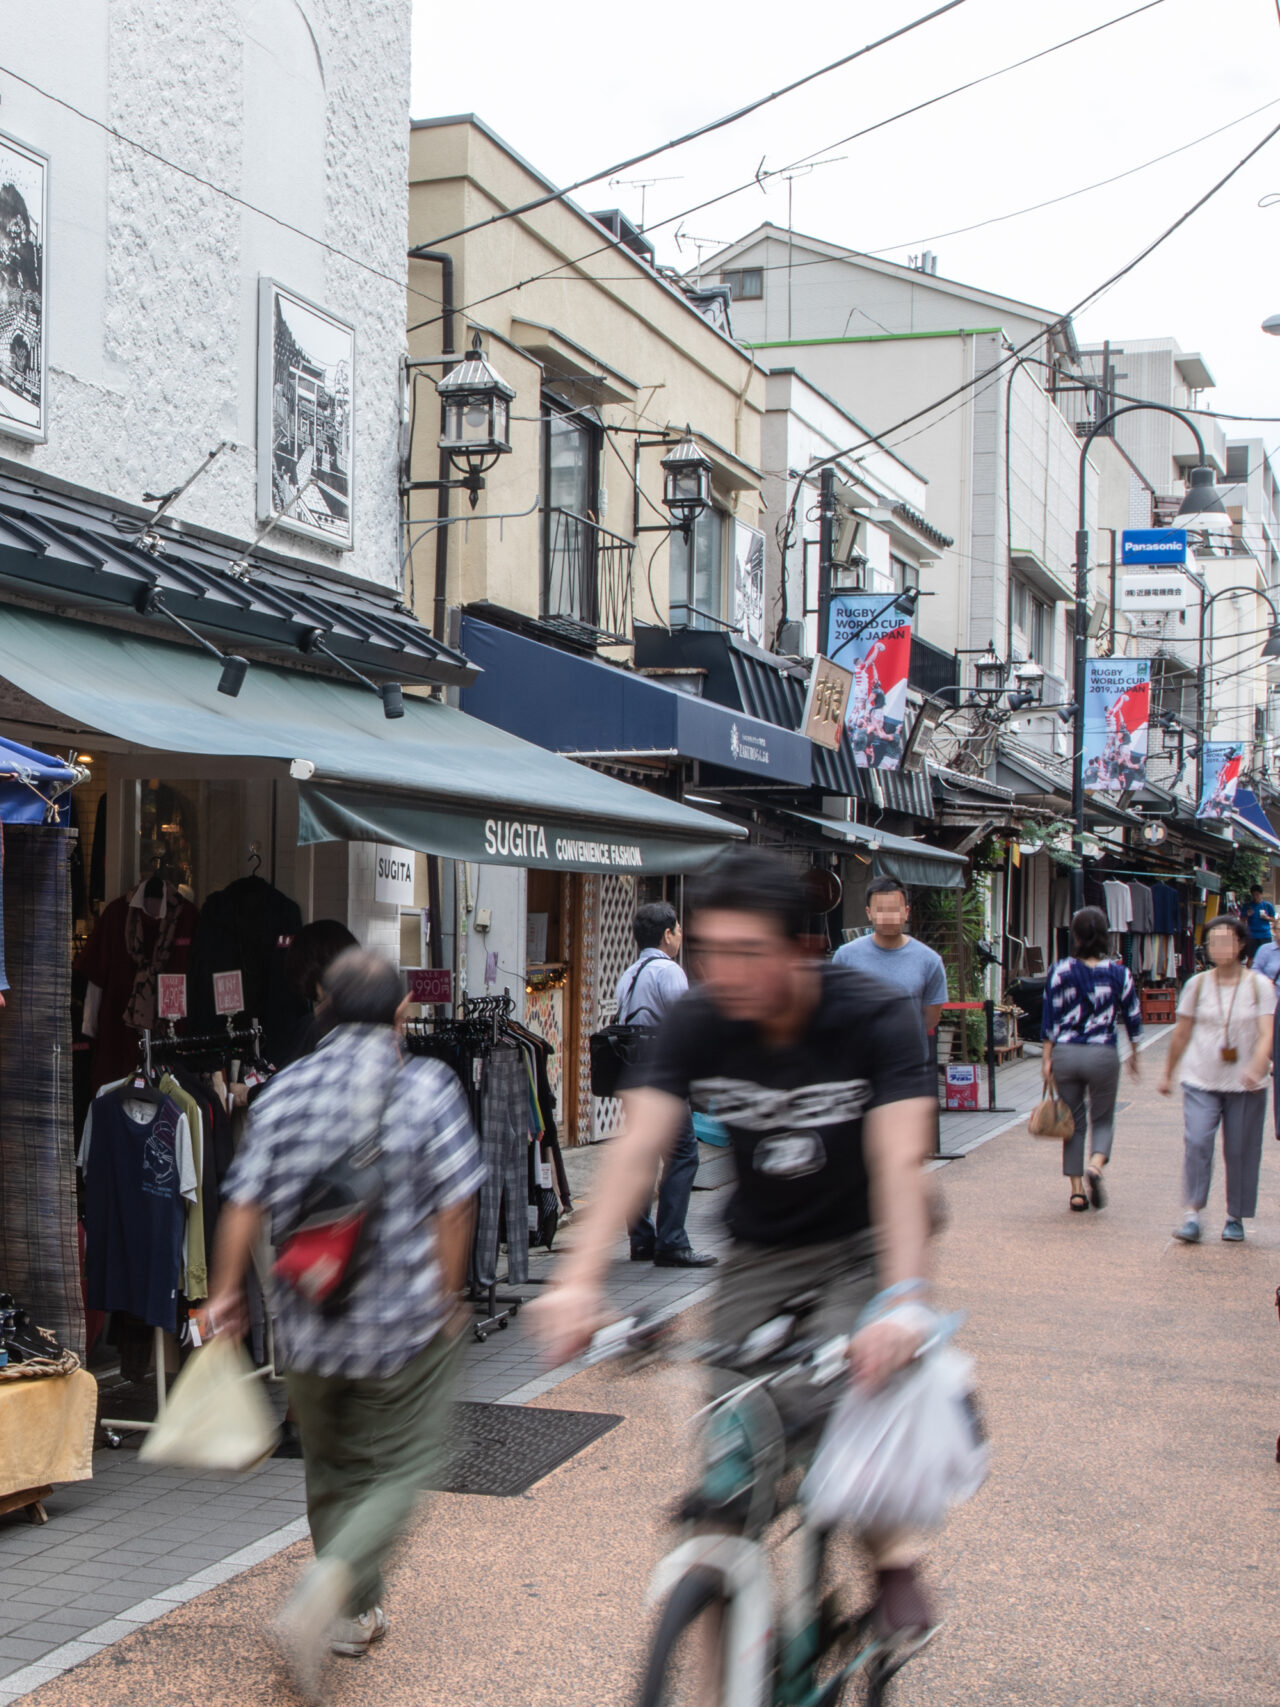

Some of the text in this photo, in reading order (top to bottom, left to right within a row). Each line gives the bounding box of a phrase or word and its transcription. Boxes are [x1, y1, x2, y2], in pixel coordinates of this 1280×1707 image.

[1125, 541, 1183, 551] Panasonic
[836, 608, 877, 618] RUGBY
[835, 619, 905, 629] WORLD CUP
[865, 631, 905, 641] JAPAN
[1091, 669, 1123, 677] RUGBY
[1090, 677, 1145, 685] WORLD CUP
[1089, 686, 1113, 694] 2019,
[484, 818, 549, 859] SUGITA
[555, 838, 643, 866] CONVENIENCE FASHION
[377, 857, 412, 884] SUGITA
